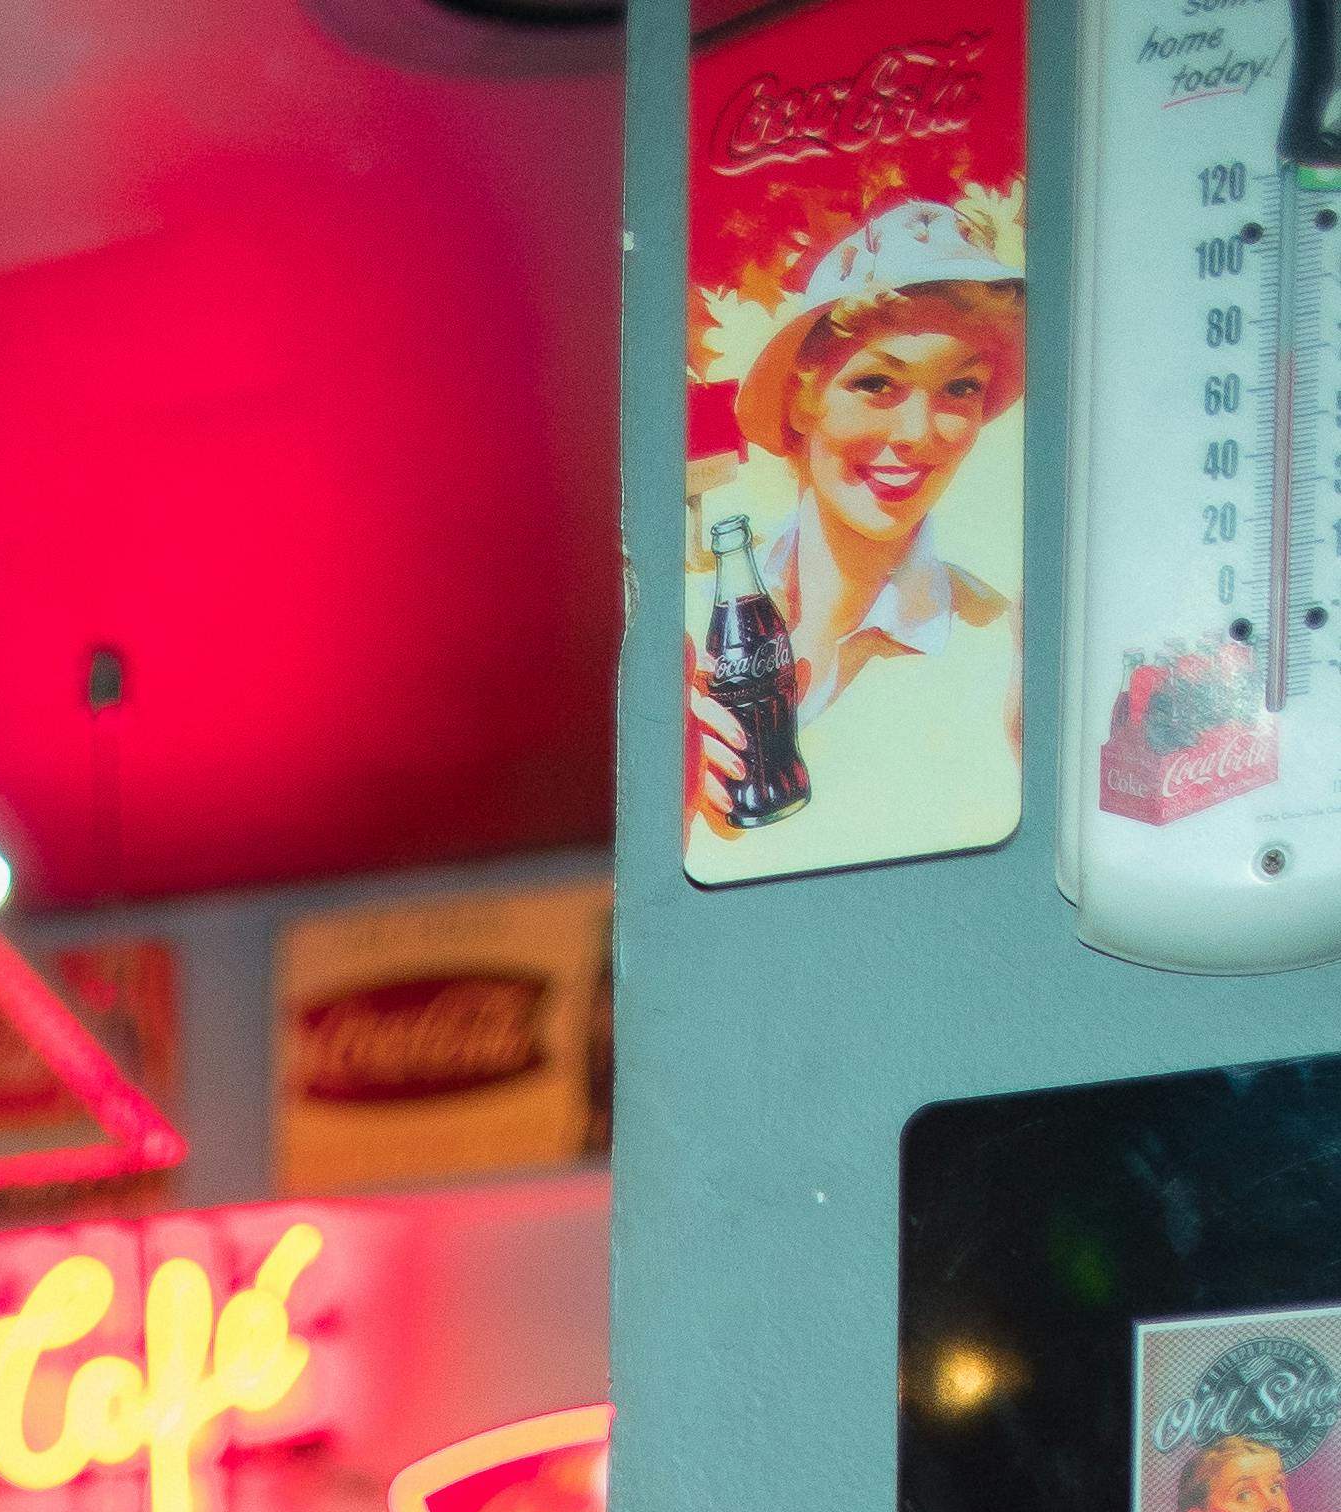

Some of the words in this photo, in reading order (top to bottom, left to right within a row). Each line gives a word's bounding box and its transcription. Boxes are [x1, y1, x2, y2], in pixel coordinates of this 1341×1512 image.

[1137, 26, 1224, 64] home
[1172, 38, 1287, 95] today!
[1198, 162, 1247, 207] 120
[1195, 234, 1244, 280] 100
[1206, 304, 1243, 348] 80
[1204, 373, 1241, 416] 60
[1203, 439, 1239, 481] 40
[1201, 502, 1237, 544] 20
[1219, 565, 1235, 605] 0
[1107, 768, 1147, 798] Coke
[1153, 1389, 1240, 1449] Old
[1311, 1412, 1337, 1428] 2.0
